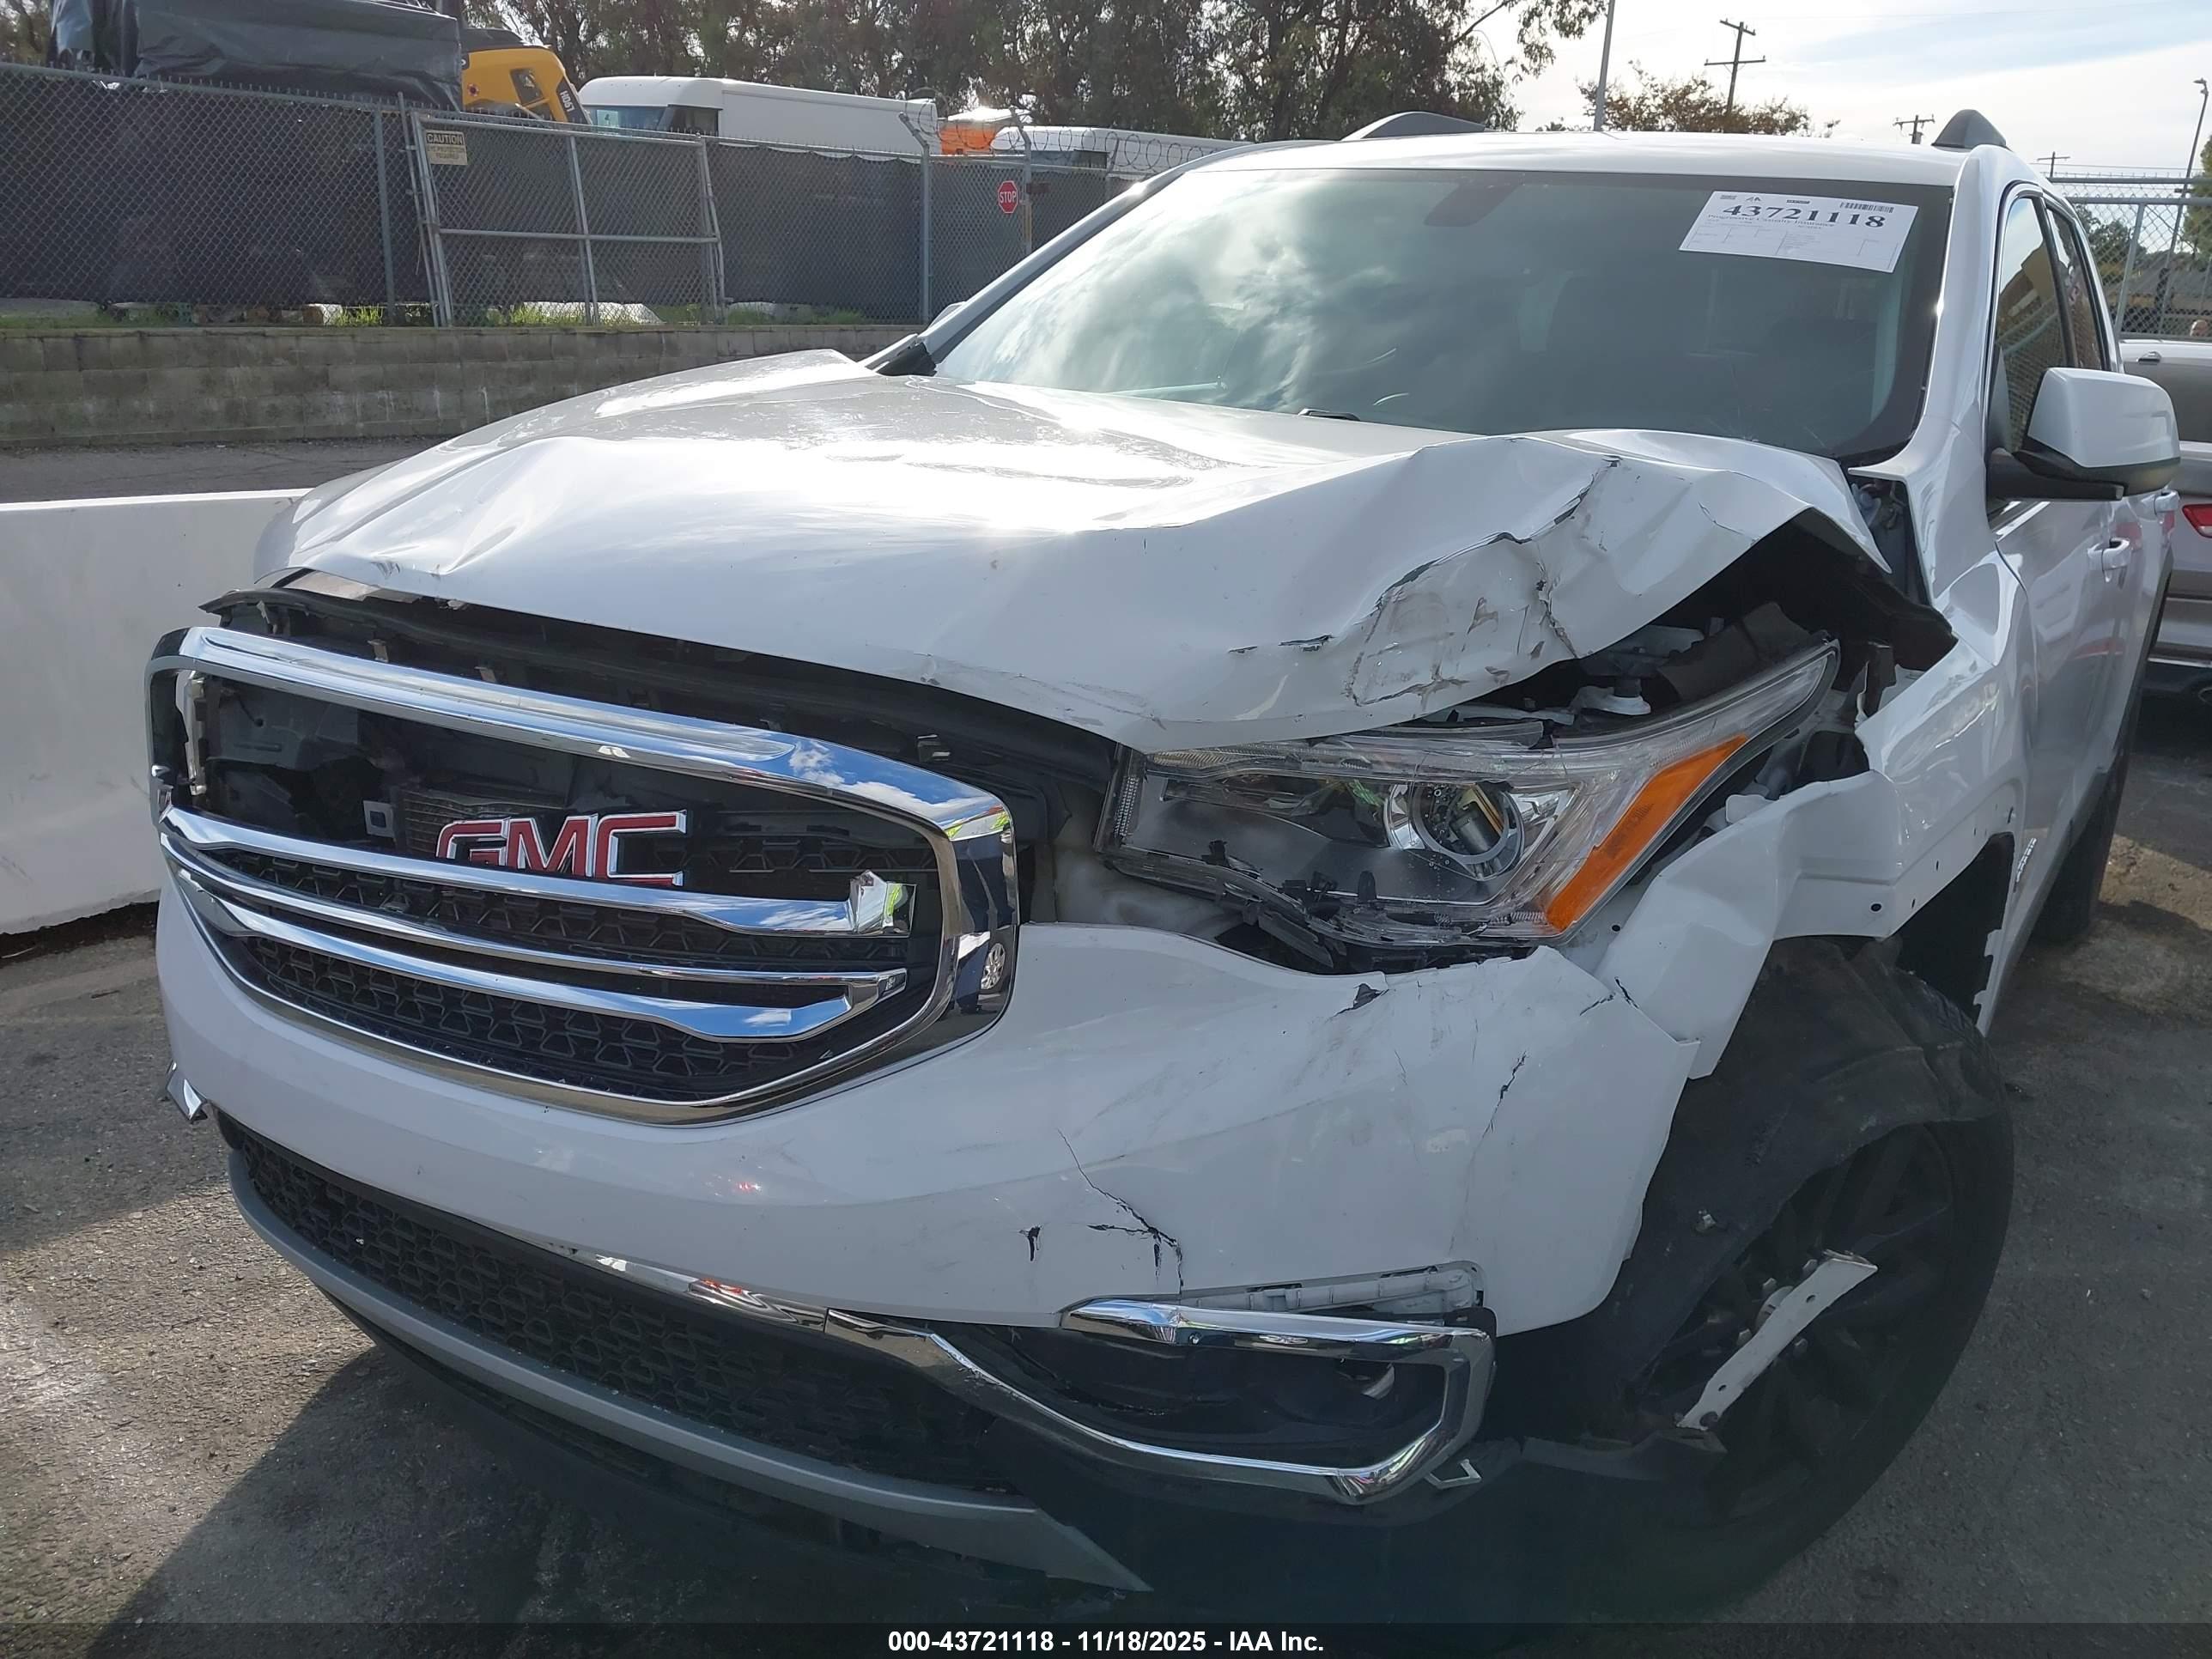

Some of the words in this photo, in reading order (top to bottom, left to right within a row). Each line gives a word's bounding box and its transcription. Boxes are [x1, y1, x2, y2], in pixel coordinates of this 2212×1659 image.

[427, 133, 463, 145] CAUTION
[1000, 191, 1017, 204] STOP
[1723, 205, 1886, 228] 43721118
[435, 810, 686, 886] GMC
